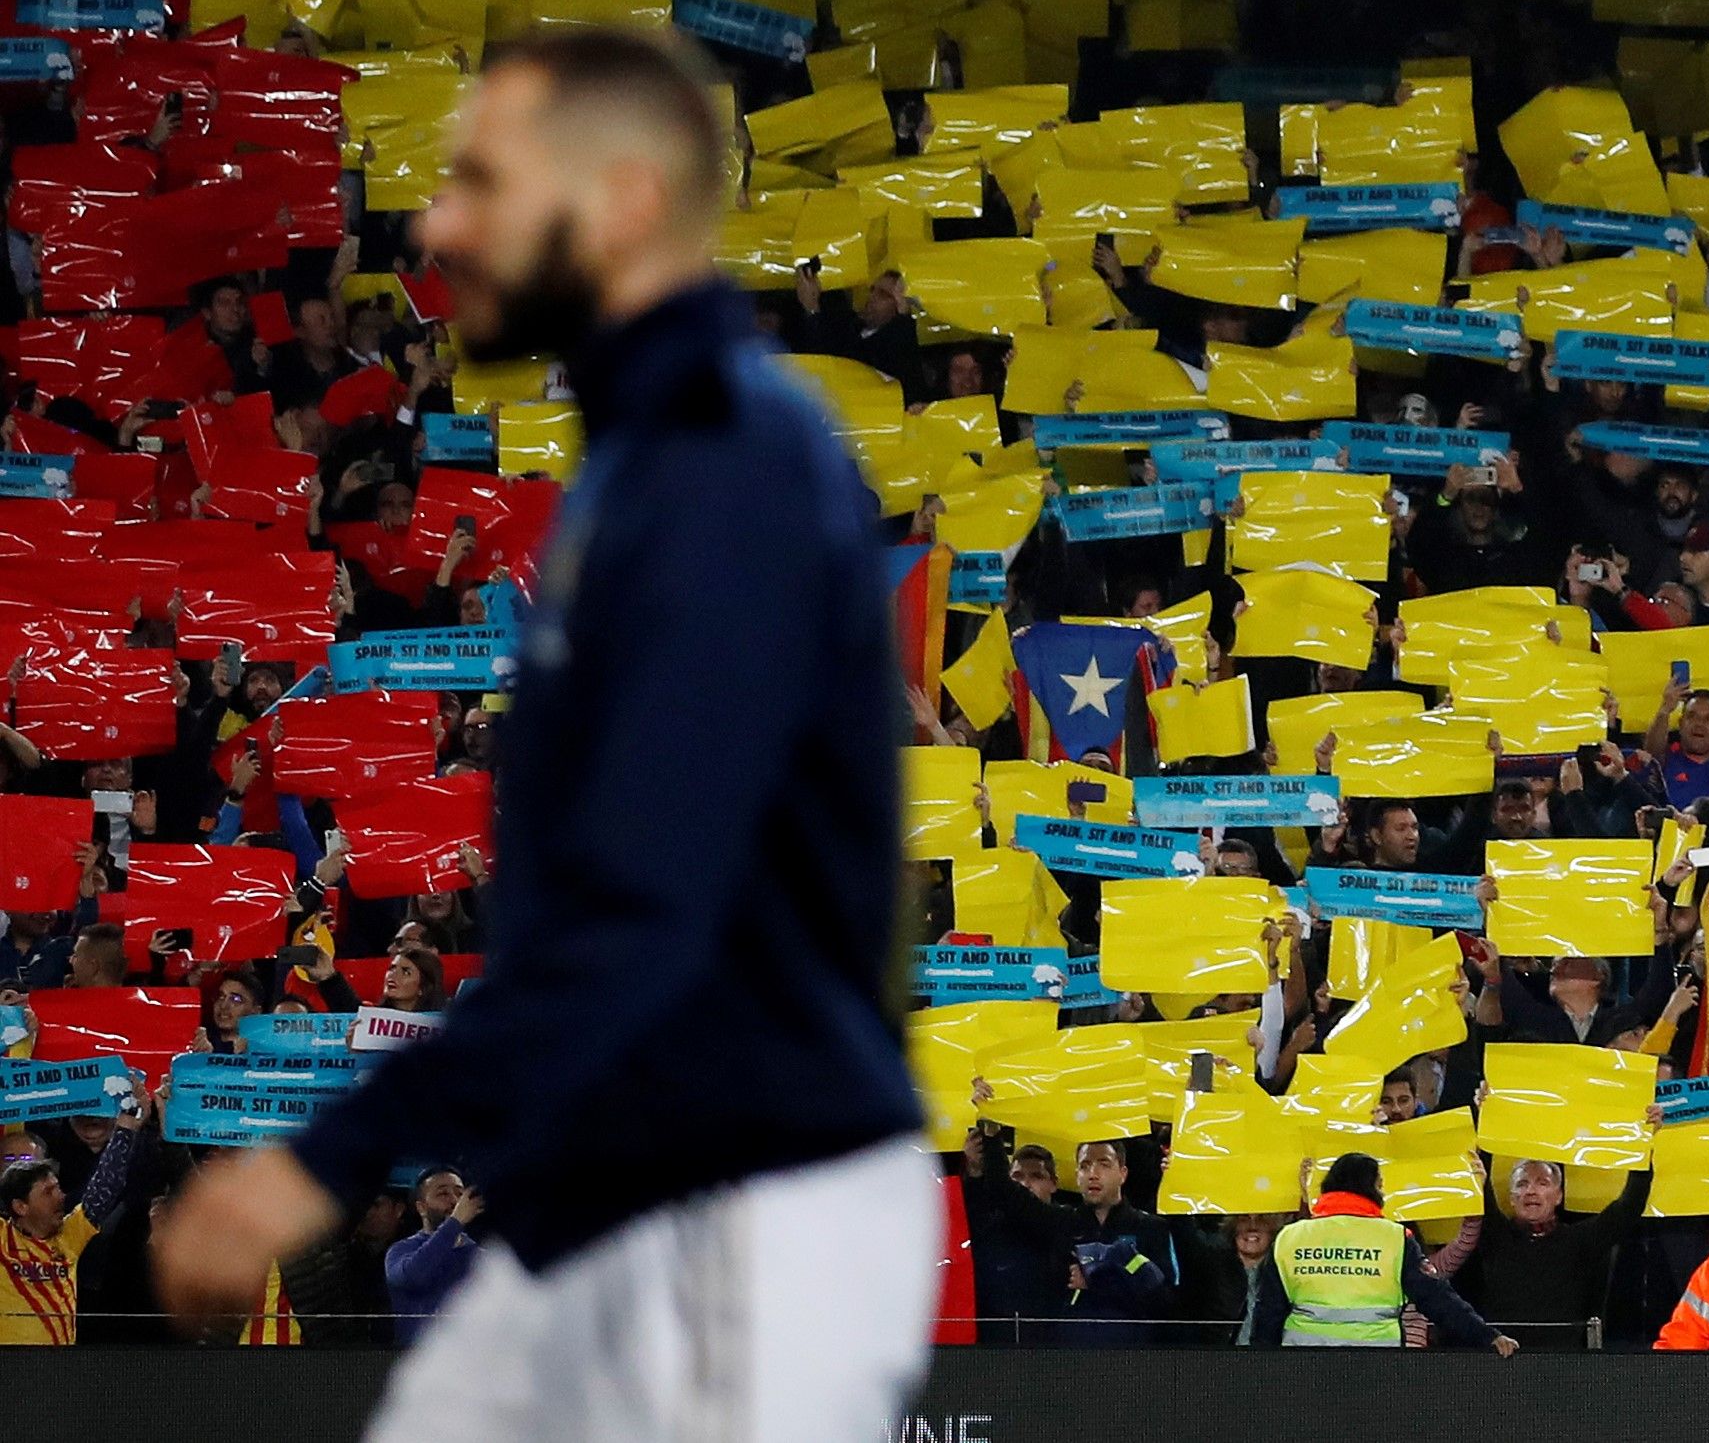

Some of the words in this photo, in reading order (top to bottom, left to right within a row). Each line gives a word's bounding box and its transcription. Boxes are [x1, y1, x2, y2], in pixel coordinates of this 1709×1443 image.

[1628, 340, 1645, 353] SIT
[1651, 342, 1674, 355] AND
[402, 646, 420, 658] SIT
[427, 646, 451, 657] AND
[457, 646, 490, 657] TALK!
[1214, 782, 1233, 794] SIT
[1240, 782, 1265, 794] AND
[1271, 782, 1305, 793] TALK!
[1090, 827, 1107, 842] SIT
[1113, 830, 1136, 845] AND
[1142, 832, 1173, 848] TALK!
[938, 952, 955, 963] SIT
[961, 952, 989, 963] AND
[995, 952, 1031, 964] TALK!
[257, 1057, 276, 1068] SIT
[283, 1058, 311, 1068] AND
[318, 1058, 355, 1069] TALK!
[13, 1074, 30, 1087] SIT
[36, 1071, 62, 1084] AND
[67, 1064, 100, 1079] TALK!
[1656, 1084, 1681, 1095] AND
[252, 1098, 272, 1112] SIT
[278, 1100, 307, 1114] AND
[1294, 1248, 1382, 1261] SEGURETAT
[1294, 1265, 1381, 1277] FCBARCELONA
